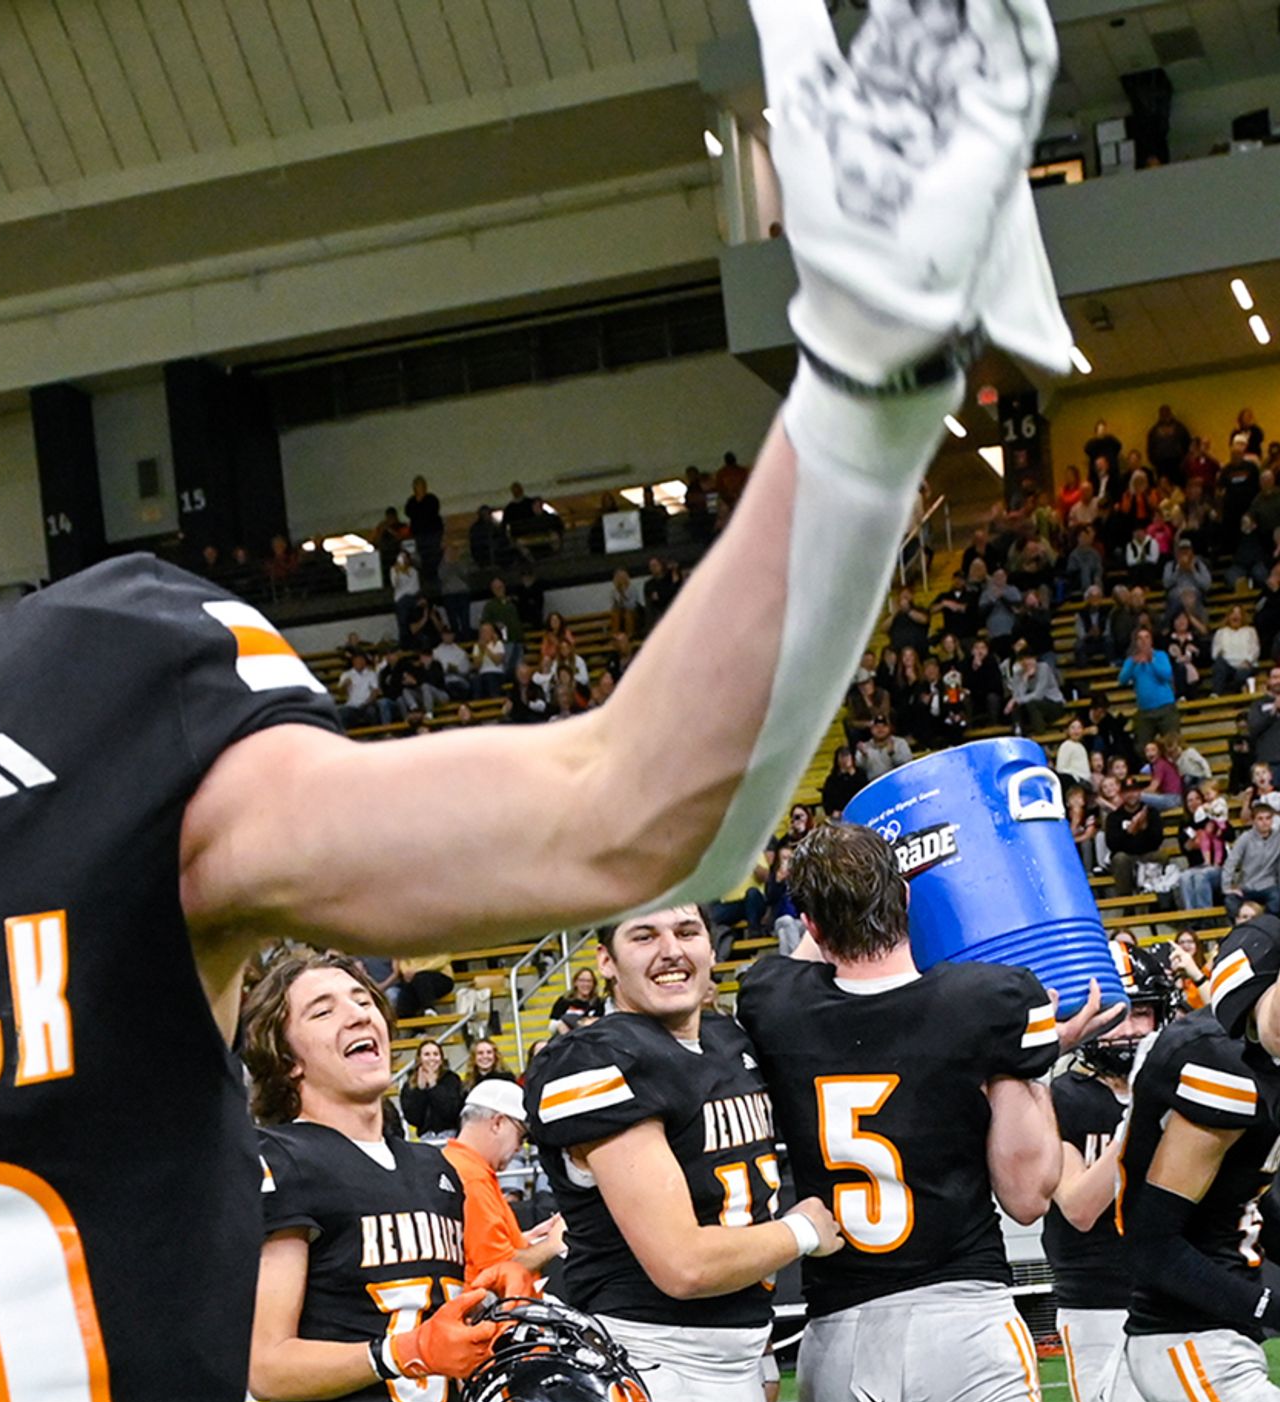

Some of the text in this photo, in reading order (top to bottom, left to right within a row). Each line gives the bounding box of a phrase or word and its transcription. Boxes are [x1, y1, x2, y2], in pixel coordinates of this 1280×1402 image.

[1003, 414, 1037, 442] 16
[179, 488, 207, 513] 15
[815, 1073, 915, 1254] 5
